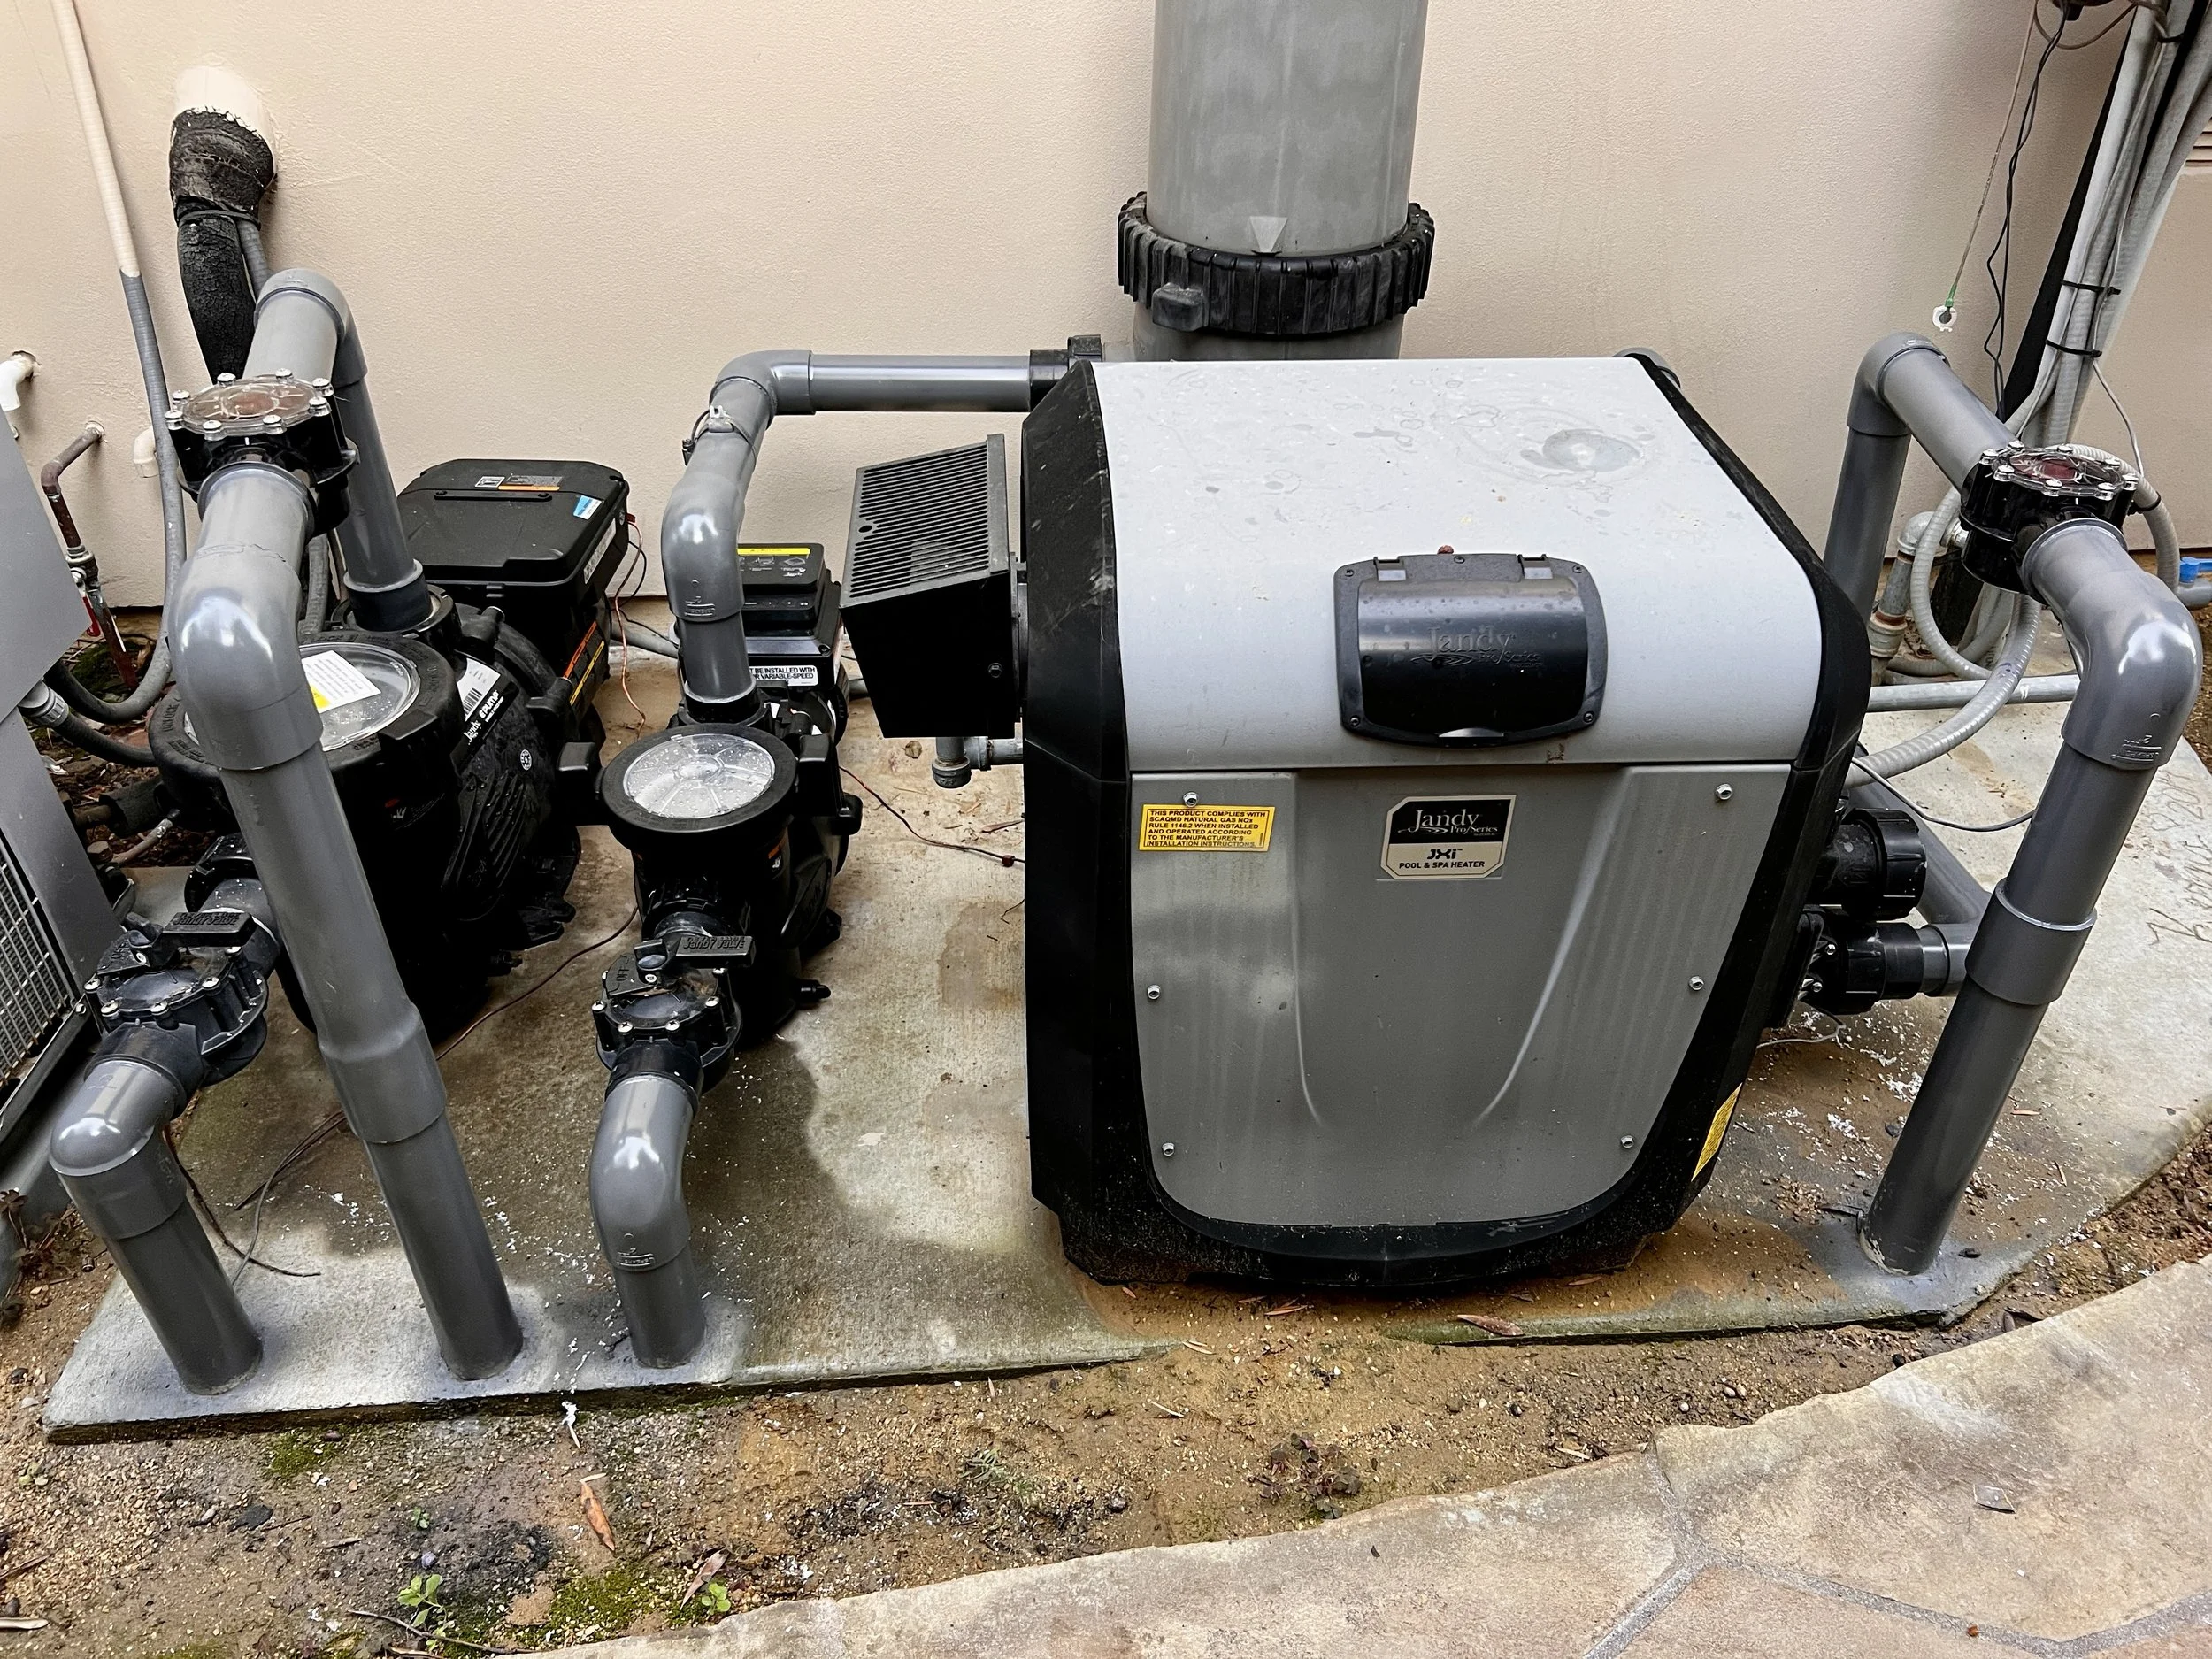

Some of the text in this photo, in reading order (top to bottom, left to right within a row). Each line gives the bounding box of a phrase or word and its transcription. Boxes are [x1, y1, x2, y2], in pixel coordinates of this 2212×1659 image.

[1427, 626, 1516, 664] Jandy
[1408, 809, 1480, 834] Jandy
[1471, 824, 1499, 833] Series
